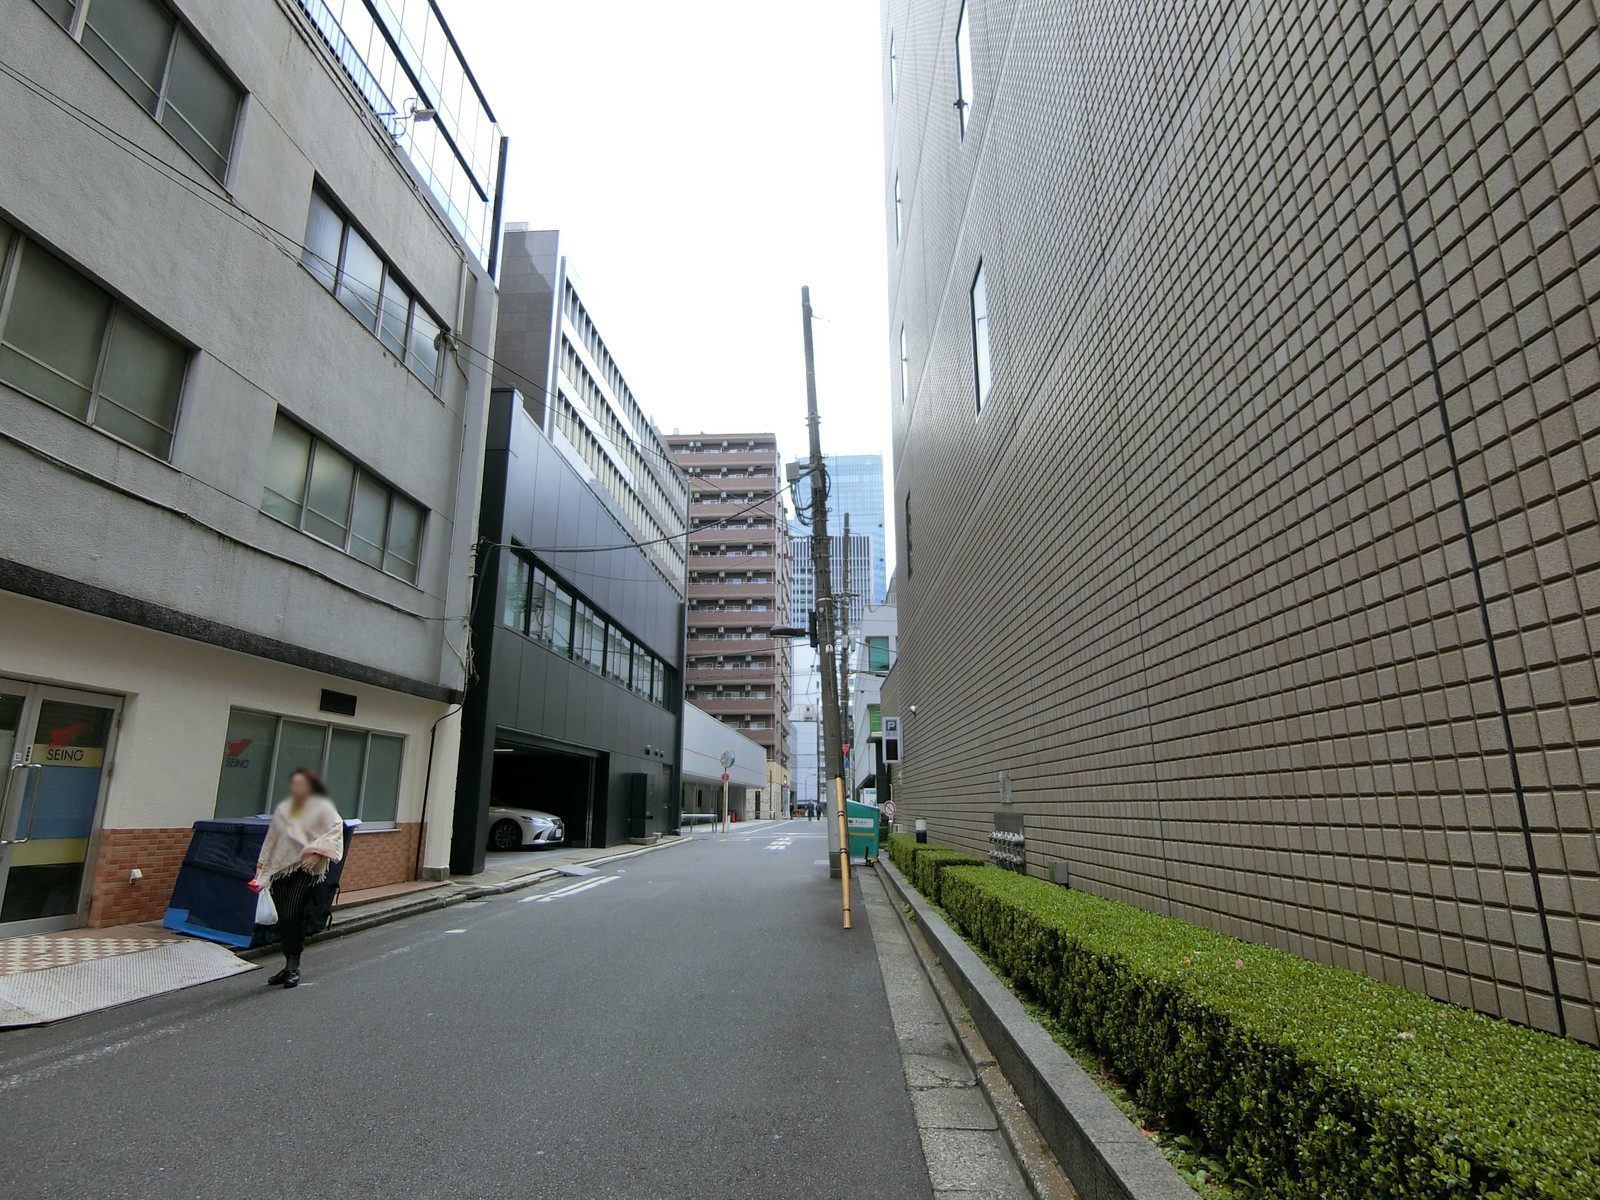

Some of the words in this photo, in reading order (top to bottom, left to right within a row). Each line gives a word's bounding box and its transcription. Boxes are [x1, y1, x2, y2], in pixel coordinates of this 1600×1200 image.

[887, 721, 896, 730] P
[46, 748, 84, 761] SEINO
[225, 757, 250, 769] SEINO
